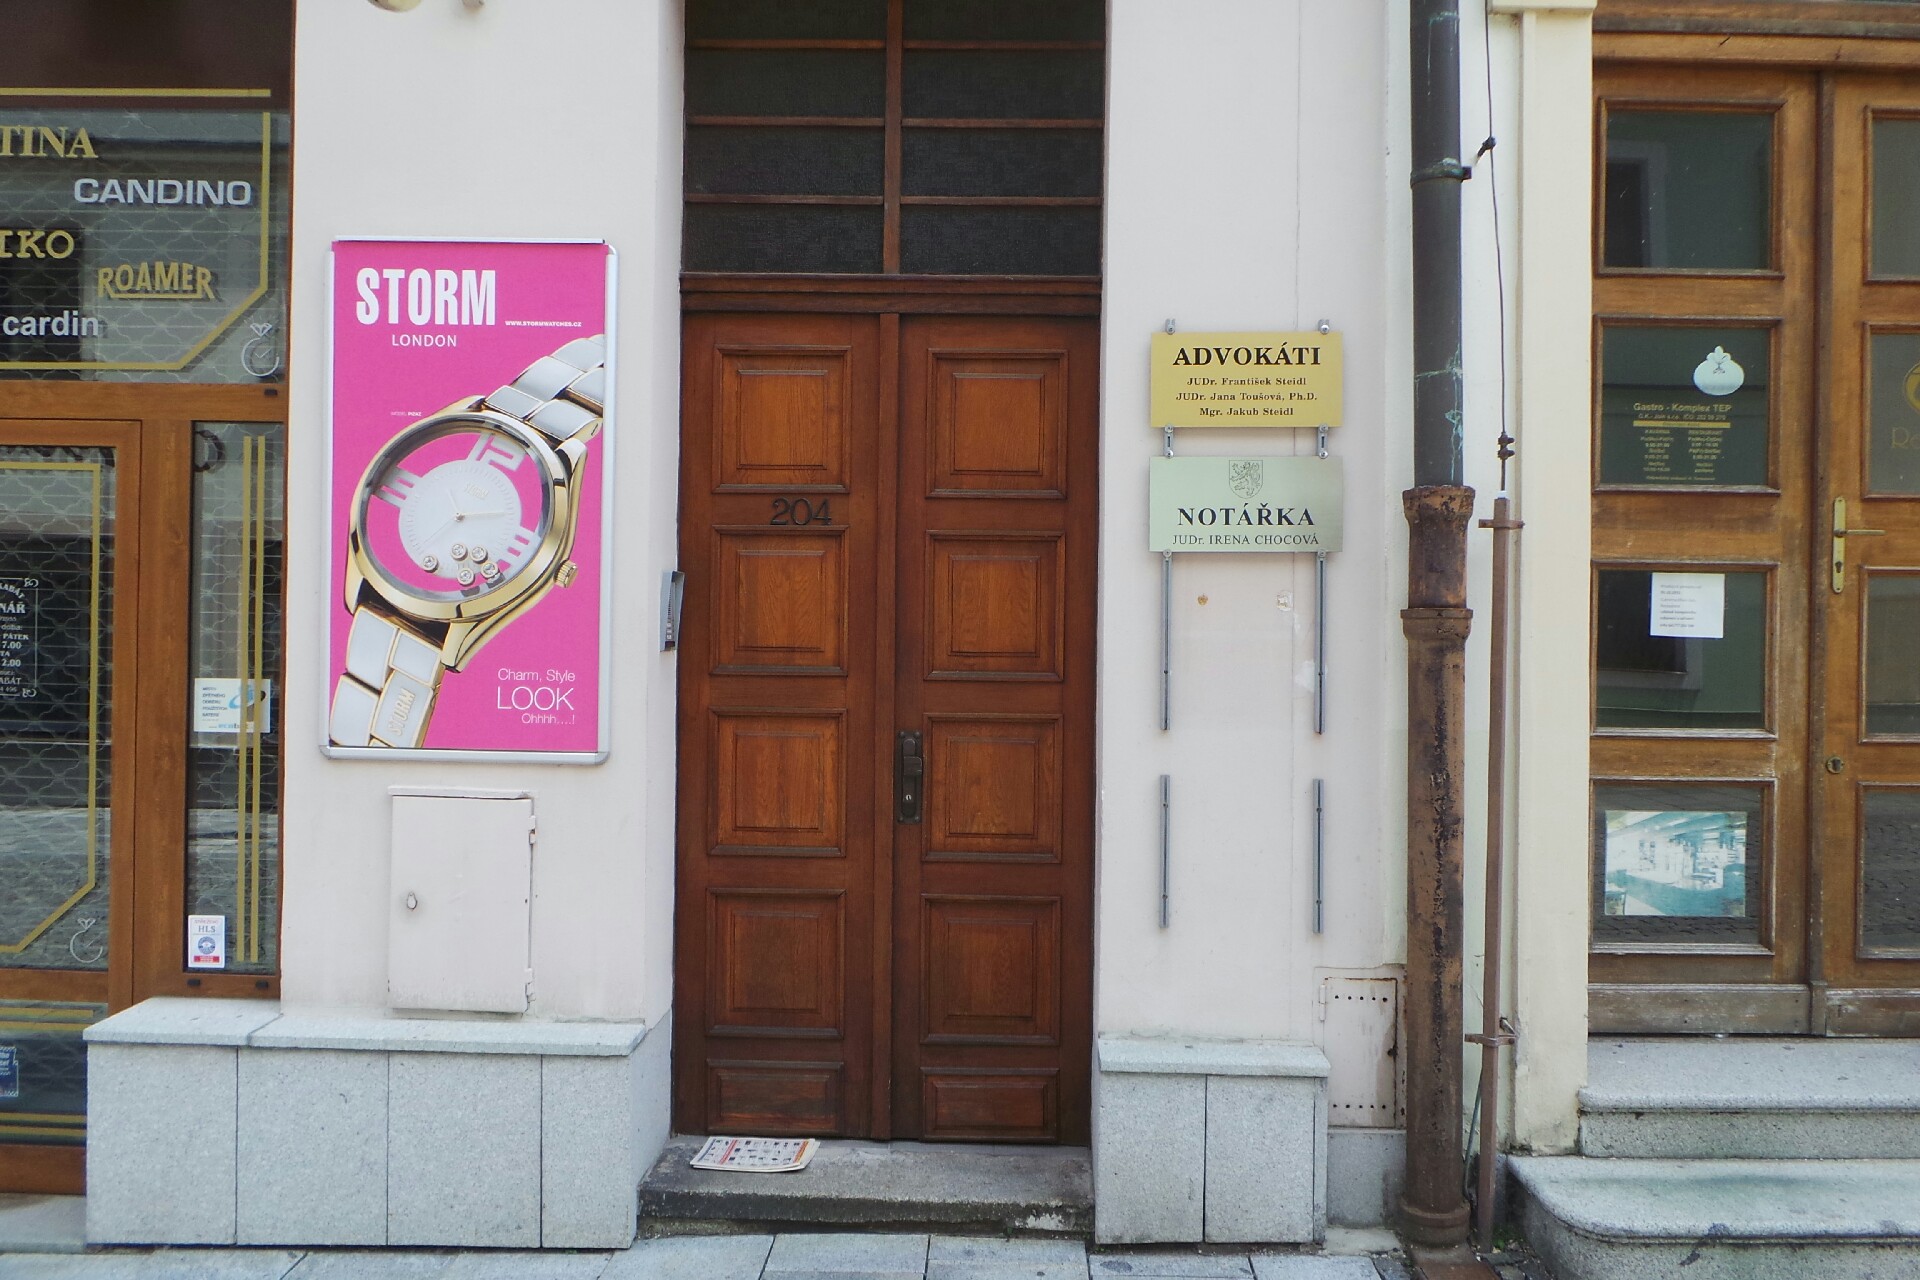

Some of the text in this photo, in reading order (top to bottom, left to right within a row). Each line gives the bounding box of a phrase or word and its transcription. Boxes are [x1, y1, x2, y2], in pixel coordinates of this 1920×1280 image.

[74, 178, 251, 206] CANDINO
[97, 260, 215, 299] ROAMER
[356, 267, 496, 326] STORM
[3, 310, 99, 336] cardin
[504, 320, 582, 328] WWW.STORMWATCHES.CZ
[392, 334, 457, 348] LONDON
[1172, 341, 1321, 366] ADVOKÁTI
[1187, 376, 1307, 386] JUDr. František Steidl
[1176, 392, 1318, 402] JUDr. Jana Toušová, Ph.D.
[1199, 407, 1294, 417] Mgr. Jakub Steidl
[1633, 402, 1664, 412] Gastro
[1671, 403, 1711, 413] Komplex
[769, 497, 832, 526] 204
[1177, 503, 1315, 526] NOTÁŘKA
[1173, 532, 1320, 545] JUDr. IRENA CHOCOVÁ
[497, 668, 576, 684] Charm, Style
[497, 686, 575, 711] LOOK
[198, 925, 217, 933] HLS
